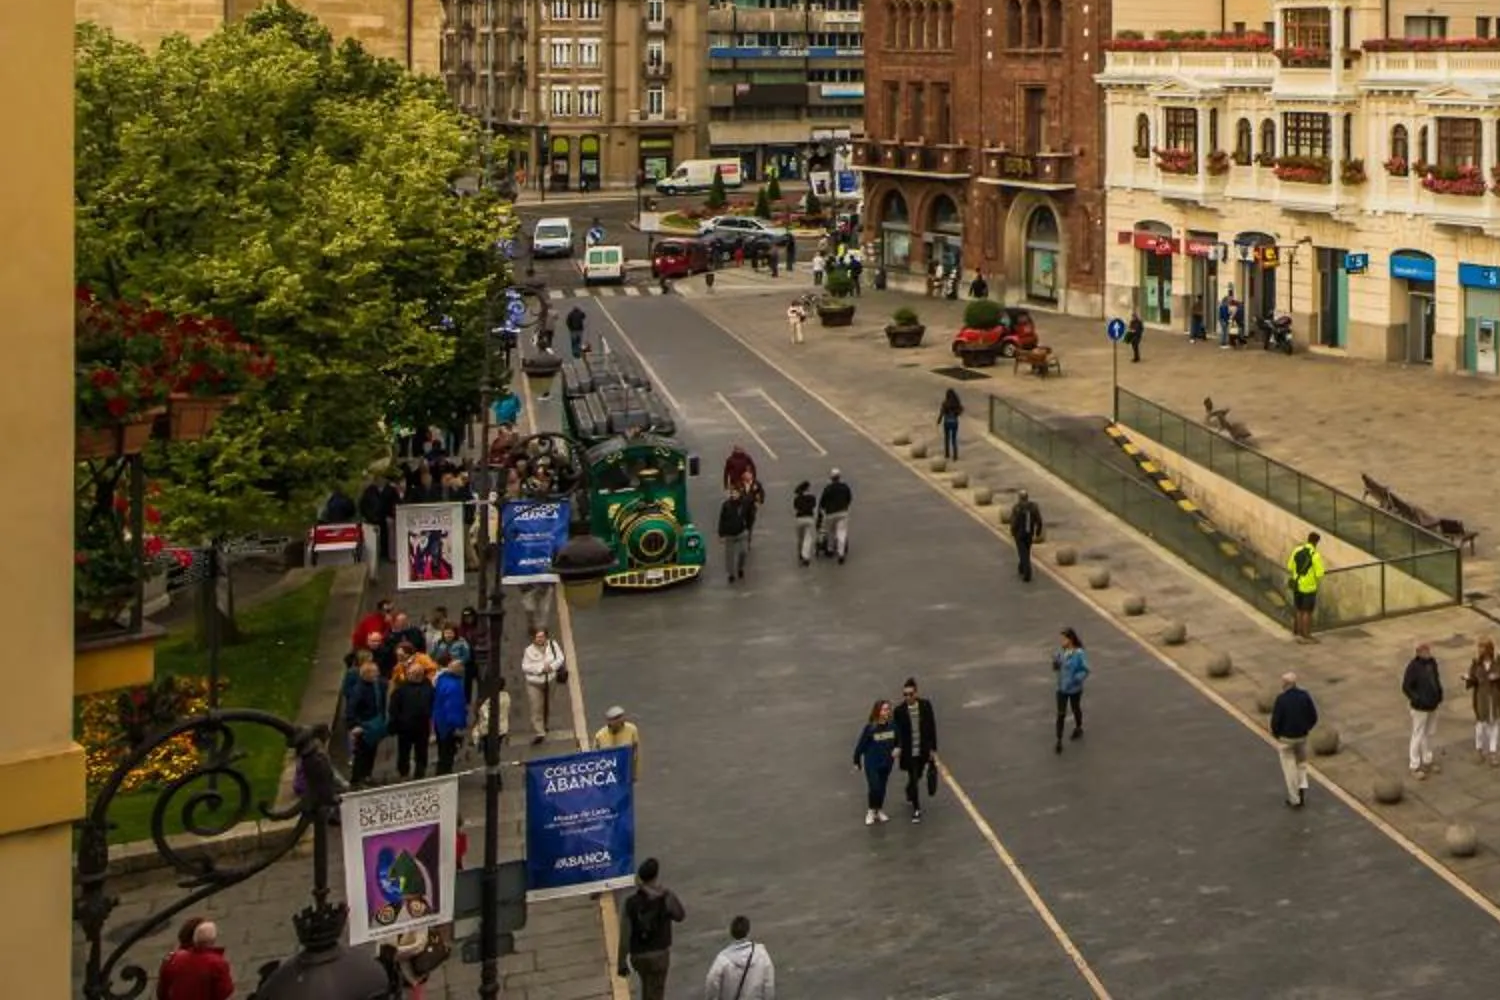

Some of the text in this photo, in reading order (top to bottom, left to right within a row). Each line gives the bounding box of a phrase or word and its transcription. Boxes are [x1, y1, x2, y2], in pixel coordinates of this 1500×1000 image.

[543, 757, 617, 779] COLECCIÓN
[545, 771, 617, 794] ABANCA
[380, 803, 440, 823] PICASSO
[554, 851, 611, 869] ABANCA
